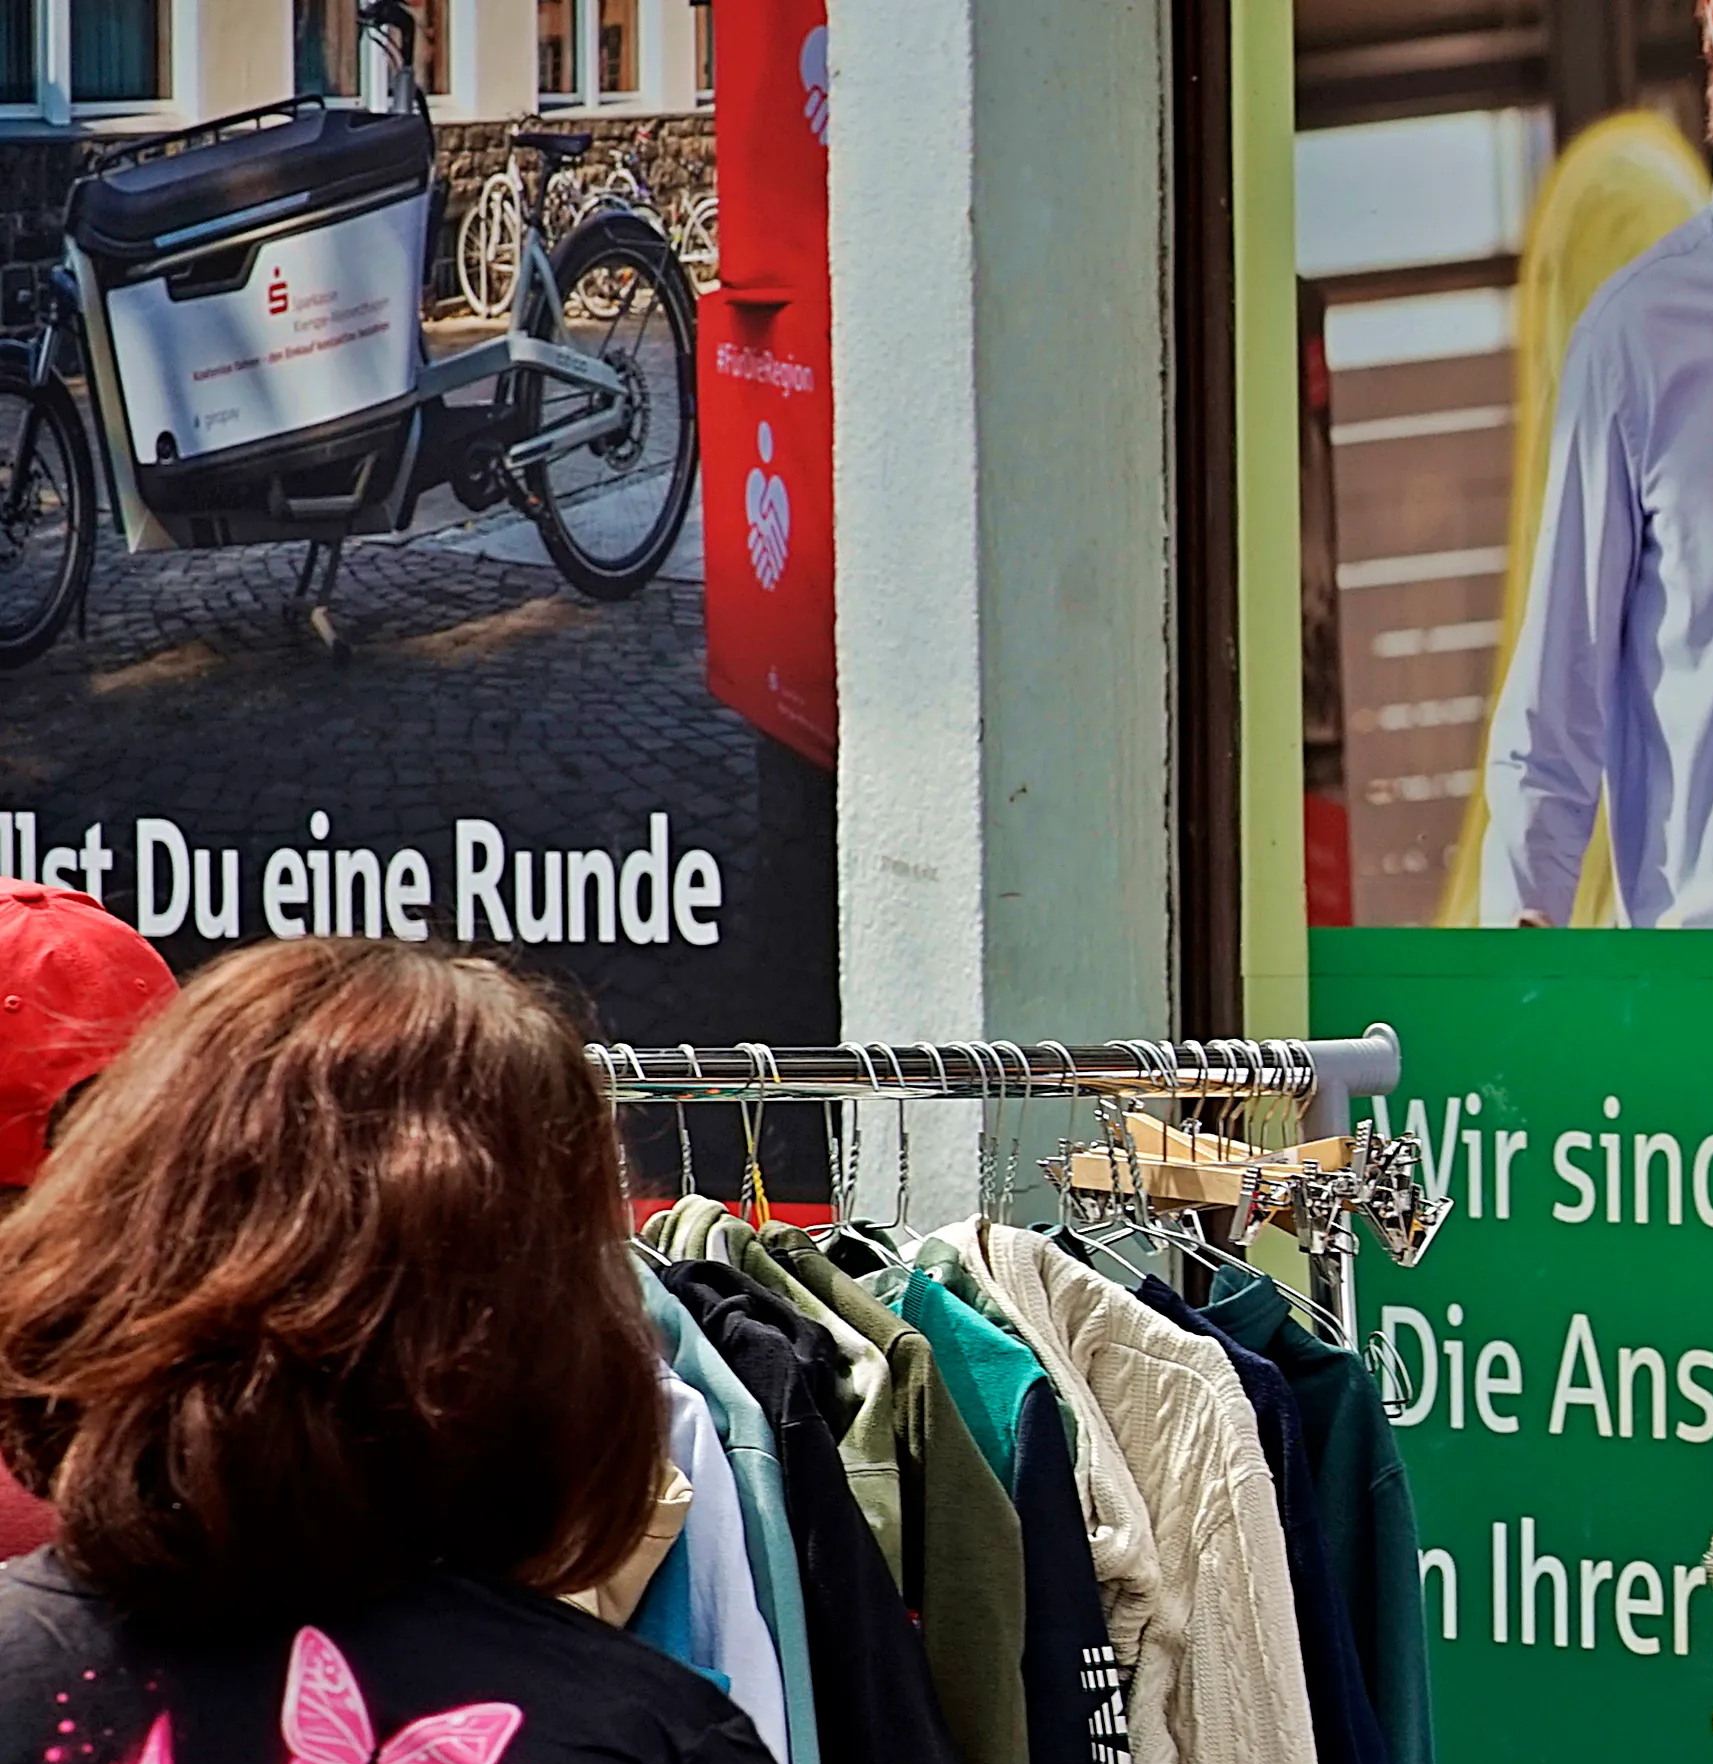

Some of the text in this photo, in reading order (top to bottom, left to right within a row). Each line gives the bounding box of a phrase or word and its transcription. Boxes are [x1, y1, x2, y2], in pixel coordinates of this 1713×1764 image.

[137, 818, 240, 939] Du
[263, 810, 432, 942] eine
[456, 812, 722, 946] Runde
[1371, 1092, 1527, 1219] Wir
[1381, 1304, 1522, 1434] Die
[1492, 1516, 1707, 1656] Ihrer
